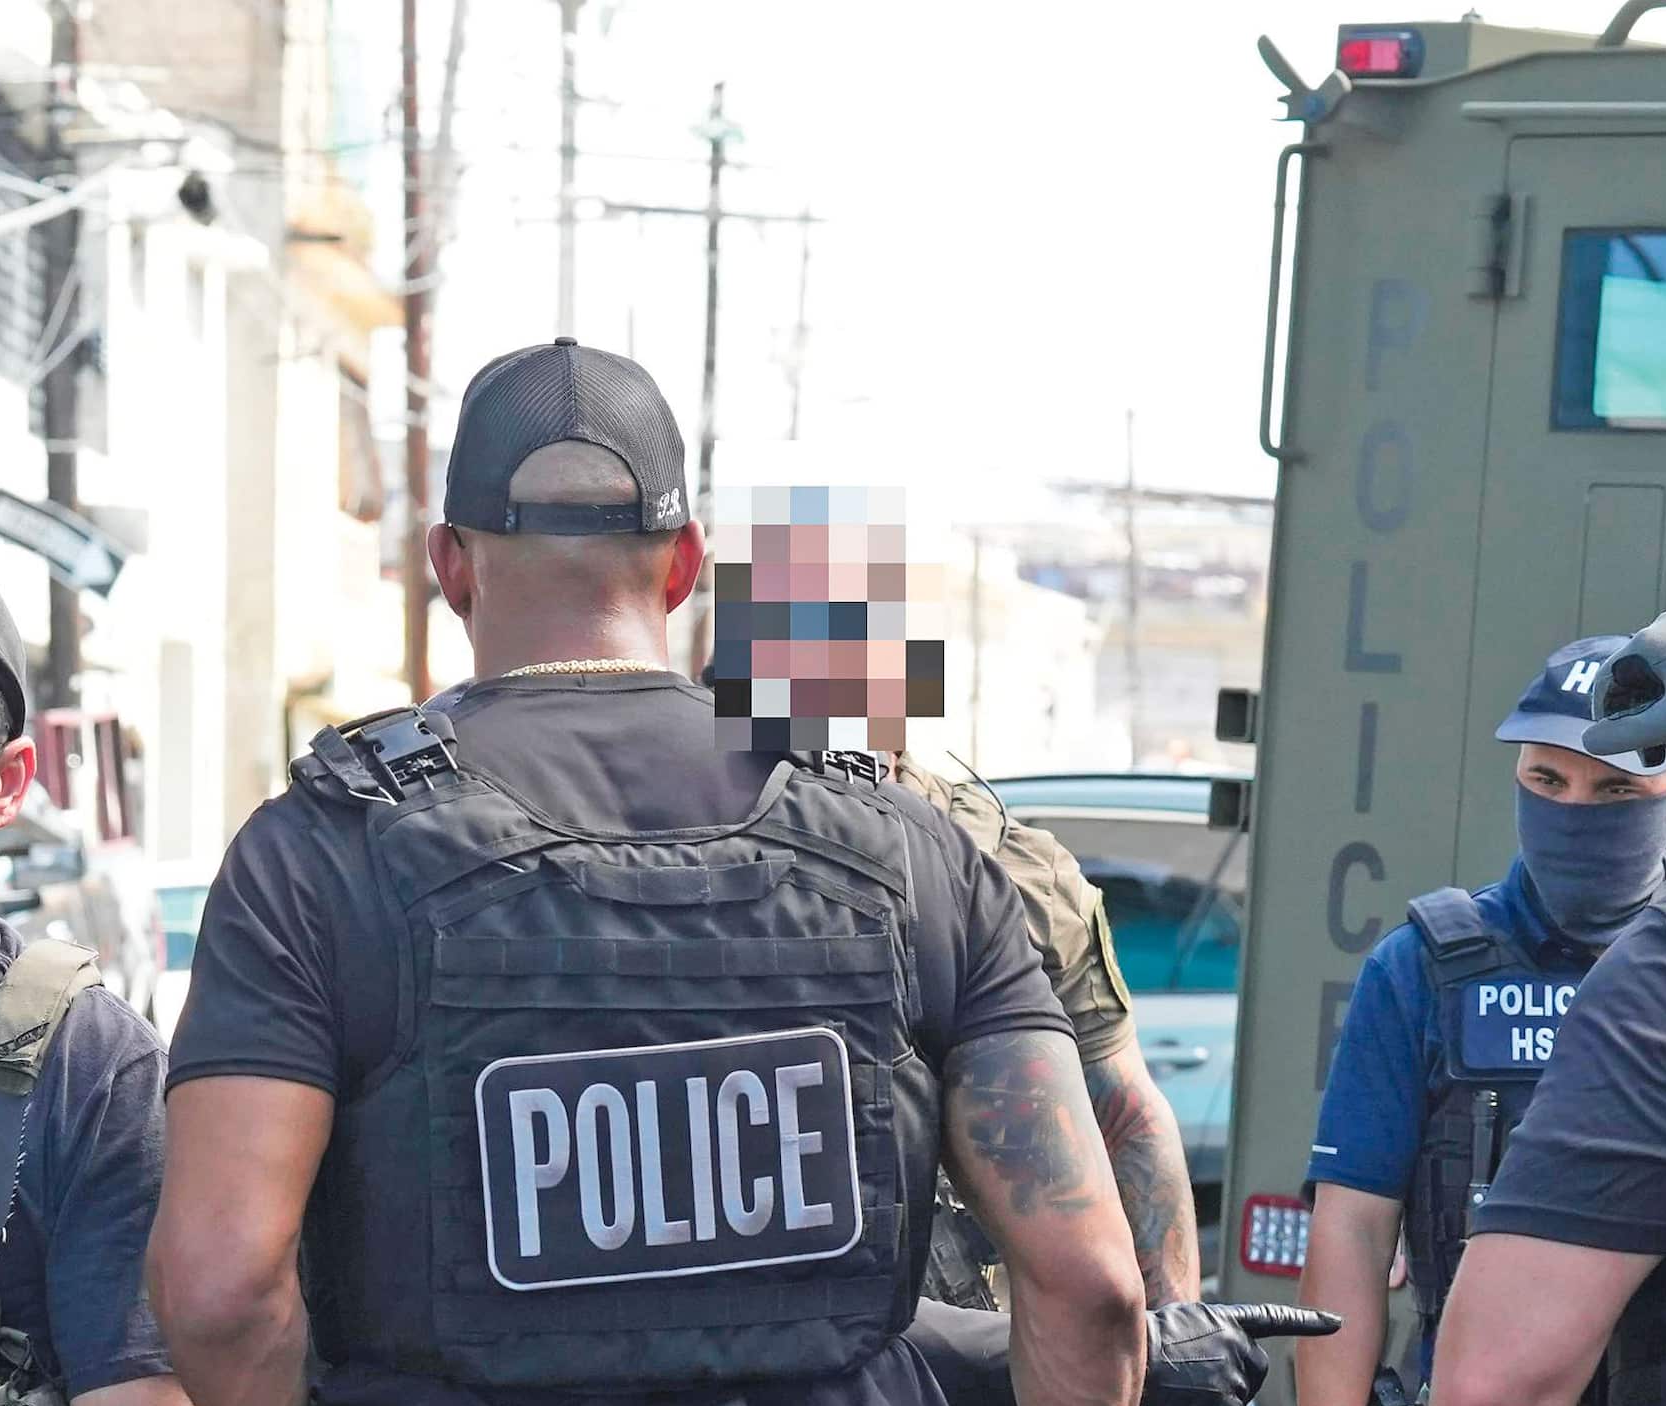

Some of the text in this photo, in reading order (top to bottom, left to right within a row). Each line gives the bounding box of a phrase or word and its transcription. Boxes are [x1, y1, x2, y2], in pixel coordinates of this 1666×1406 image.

[1478, 984, 1576, 1016] POLIC
[1511, 1027, 1560, 1061] HS
[509, 1061, 833, 1258] POLICE
